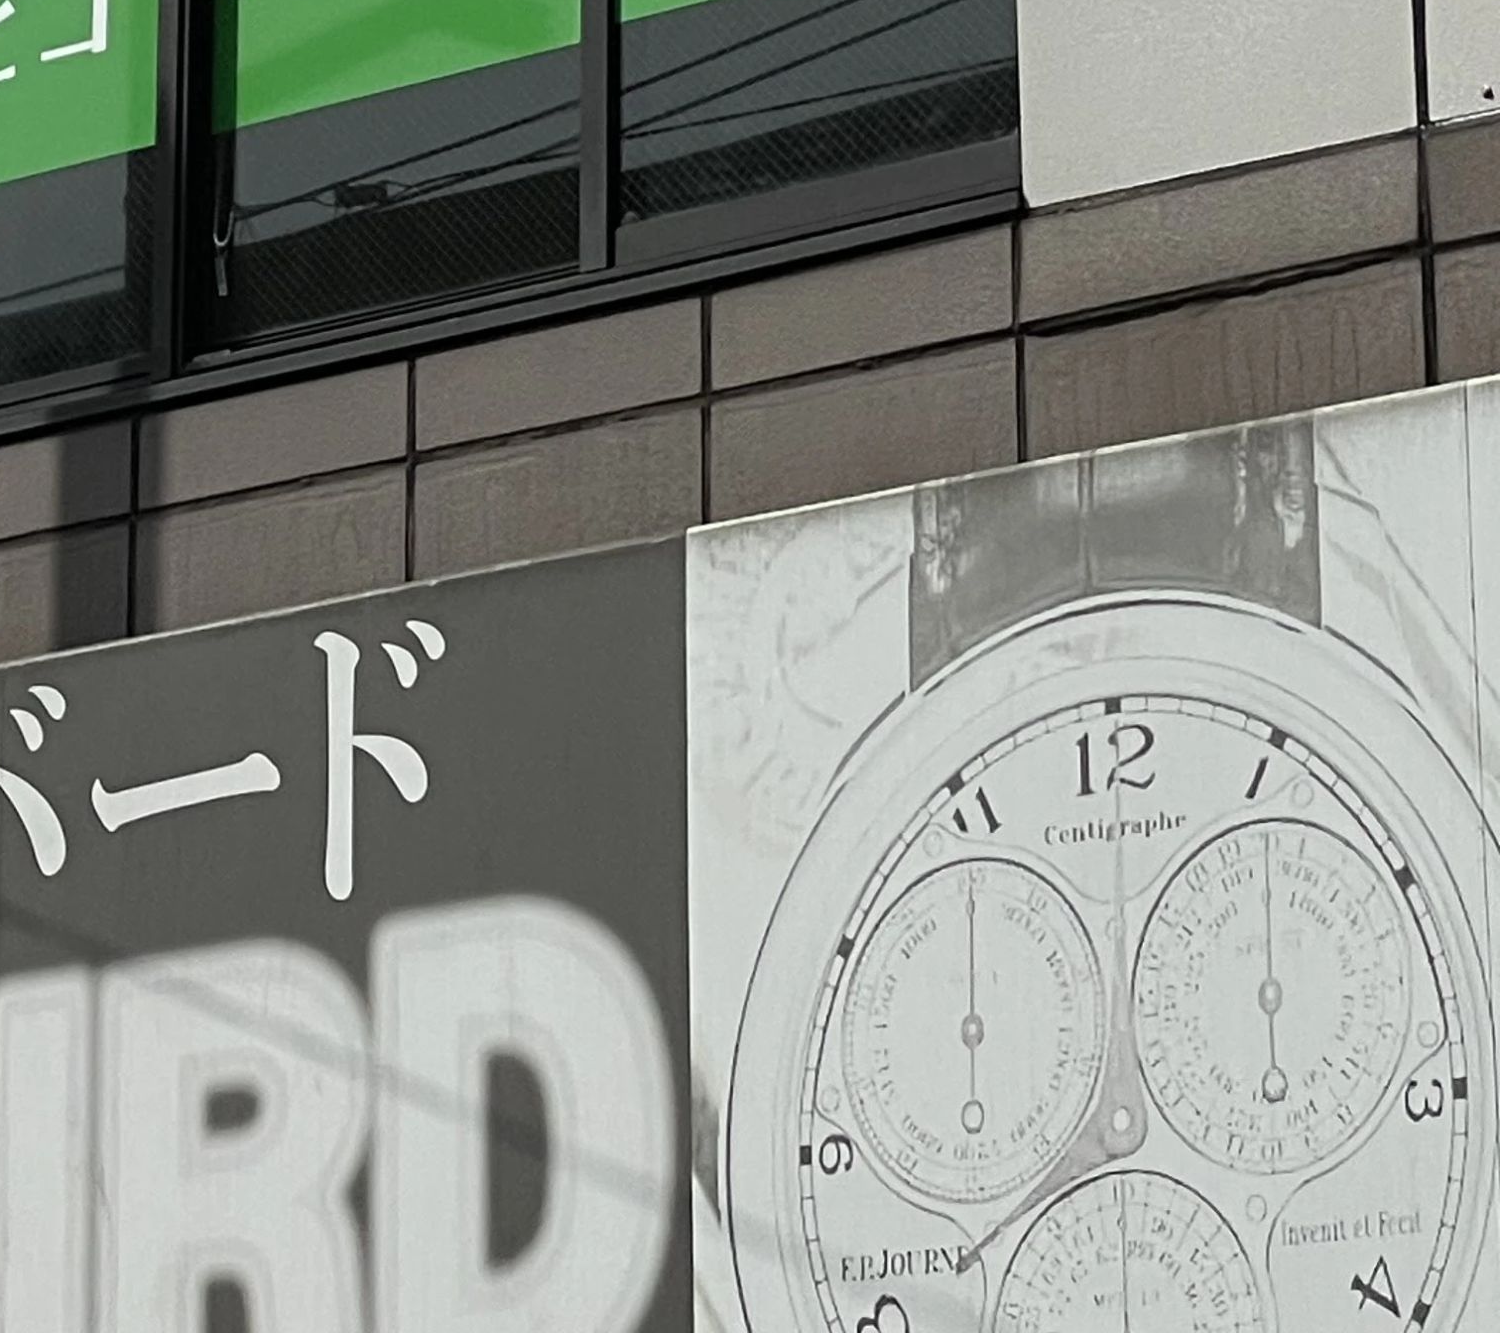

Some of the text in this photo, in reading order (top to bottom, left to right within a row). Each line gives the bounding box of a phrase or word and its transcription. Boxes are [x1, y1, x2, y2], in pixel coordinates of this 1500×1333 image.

[1076, 724, 1156, 797] 12
[1405, 1079, 1445, 1122] 3
[1350, 1255, 1402, 1319] 4
